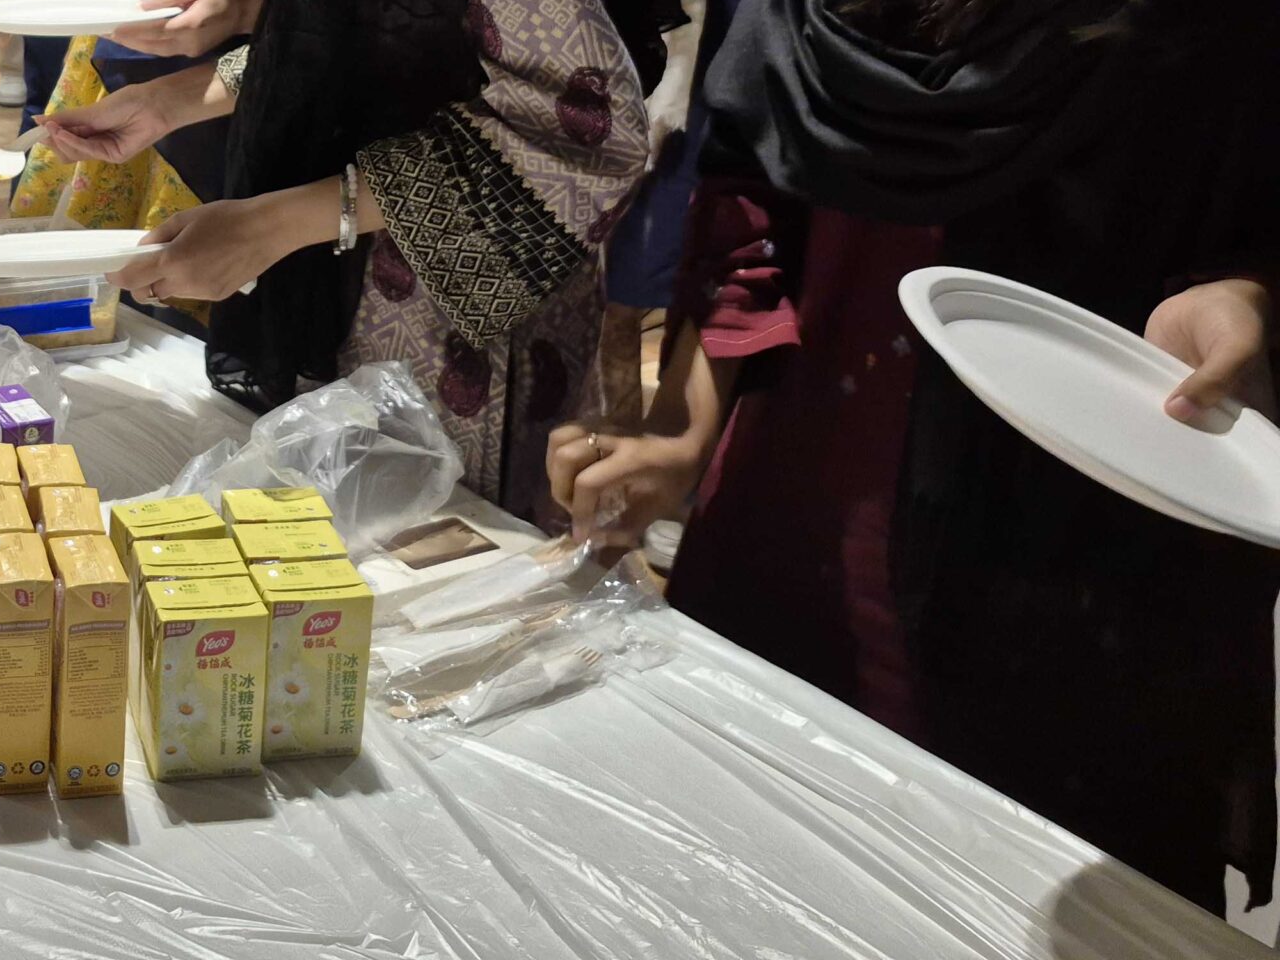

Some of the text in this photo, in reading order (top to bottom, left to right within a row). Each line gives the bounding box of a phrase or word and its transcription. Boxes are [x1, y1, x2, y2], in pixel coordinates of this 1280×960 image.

[202, 637, 229, 653] Yeo's
[310, 617, 336, 632] Yeo's
[235, 672, 256, 755] 冰糖菊花茶
[339, 652, 359, 735] 冰糖菊花茶
